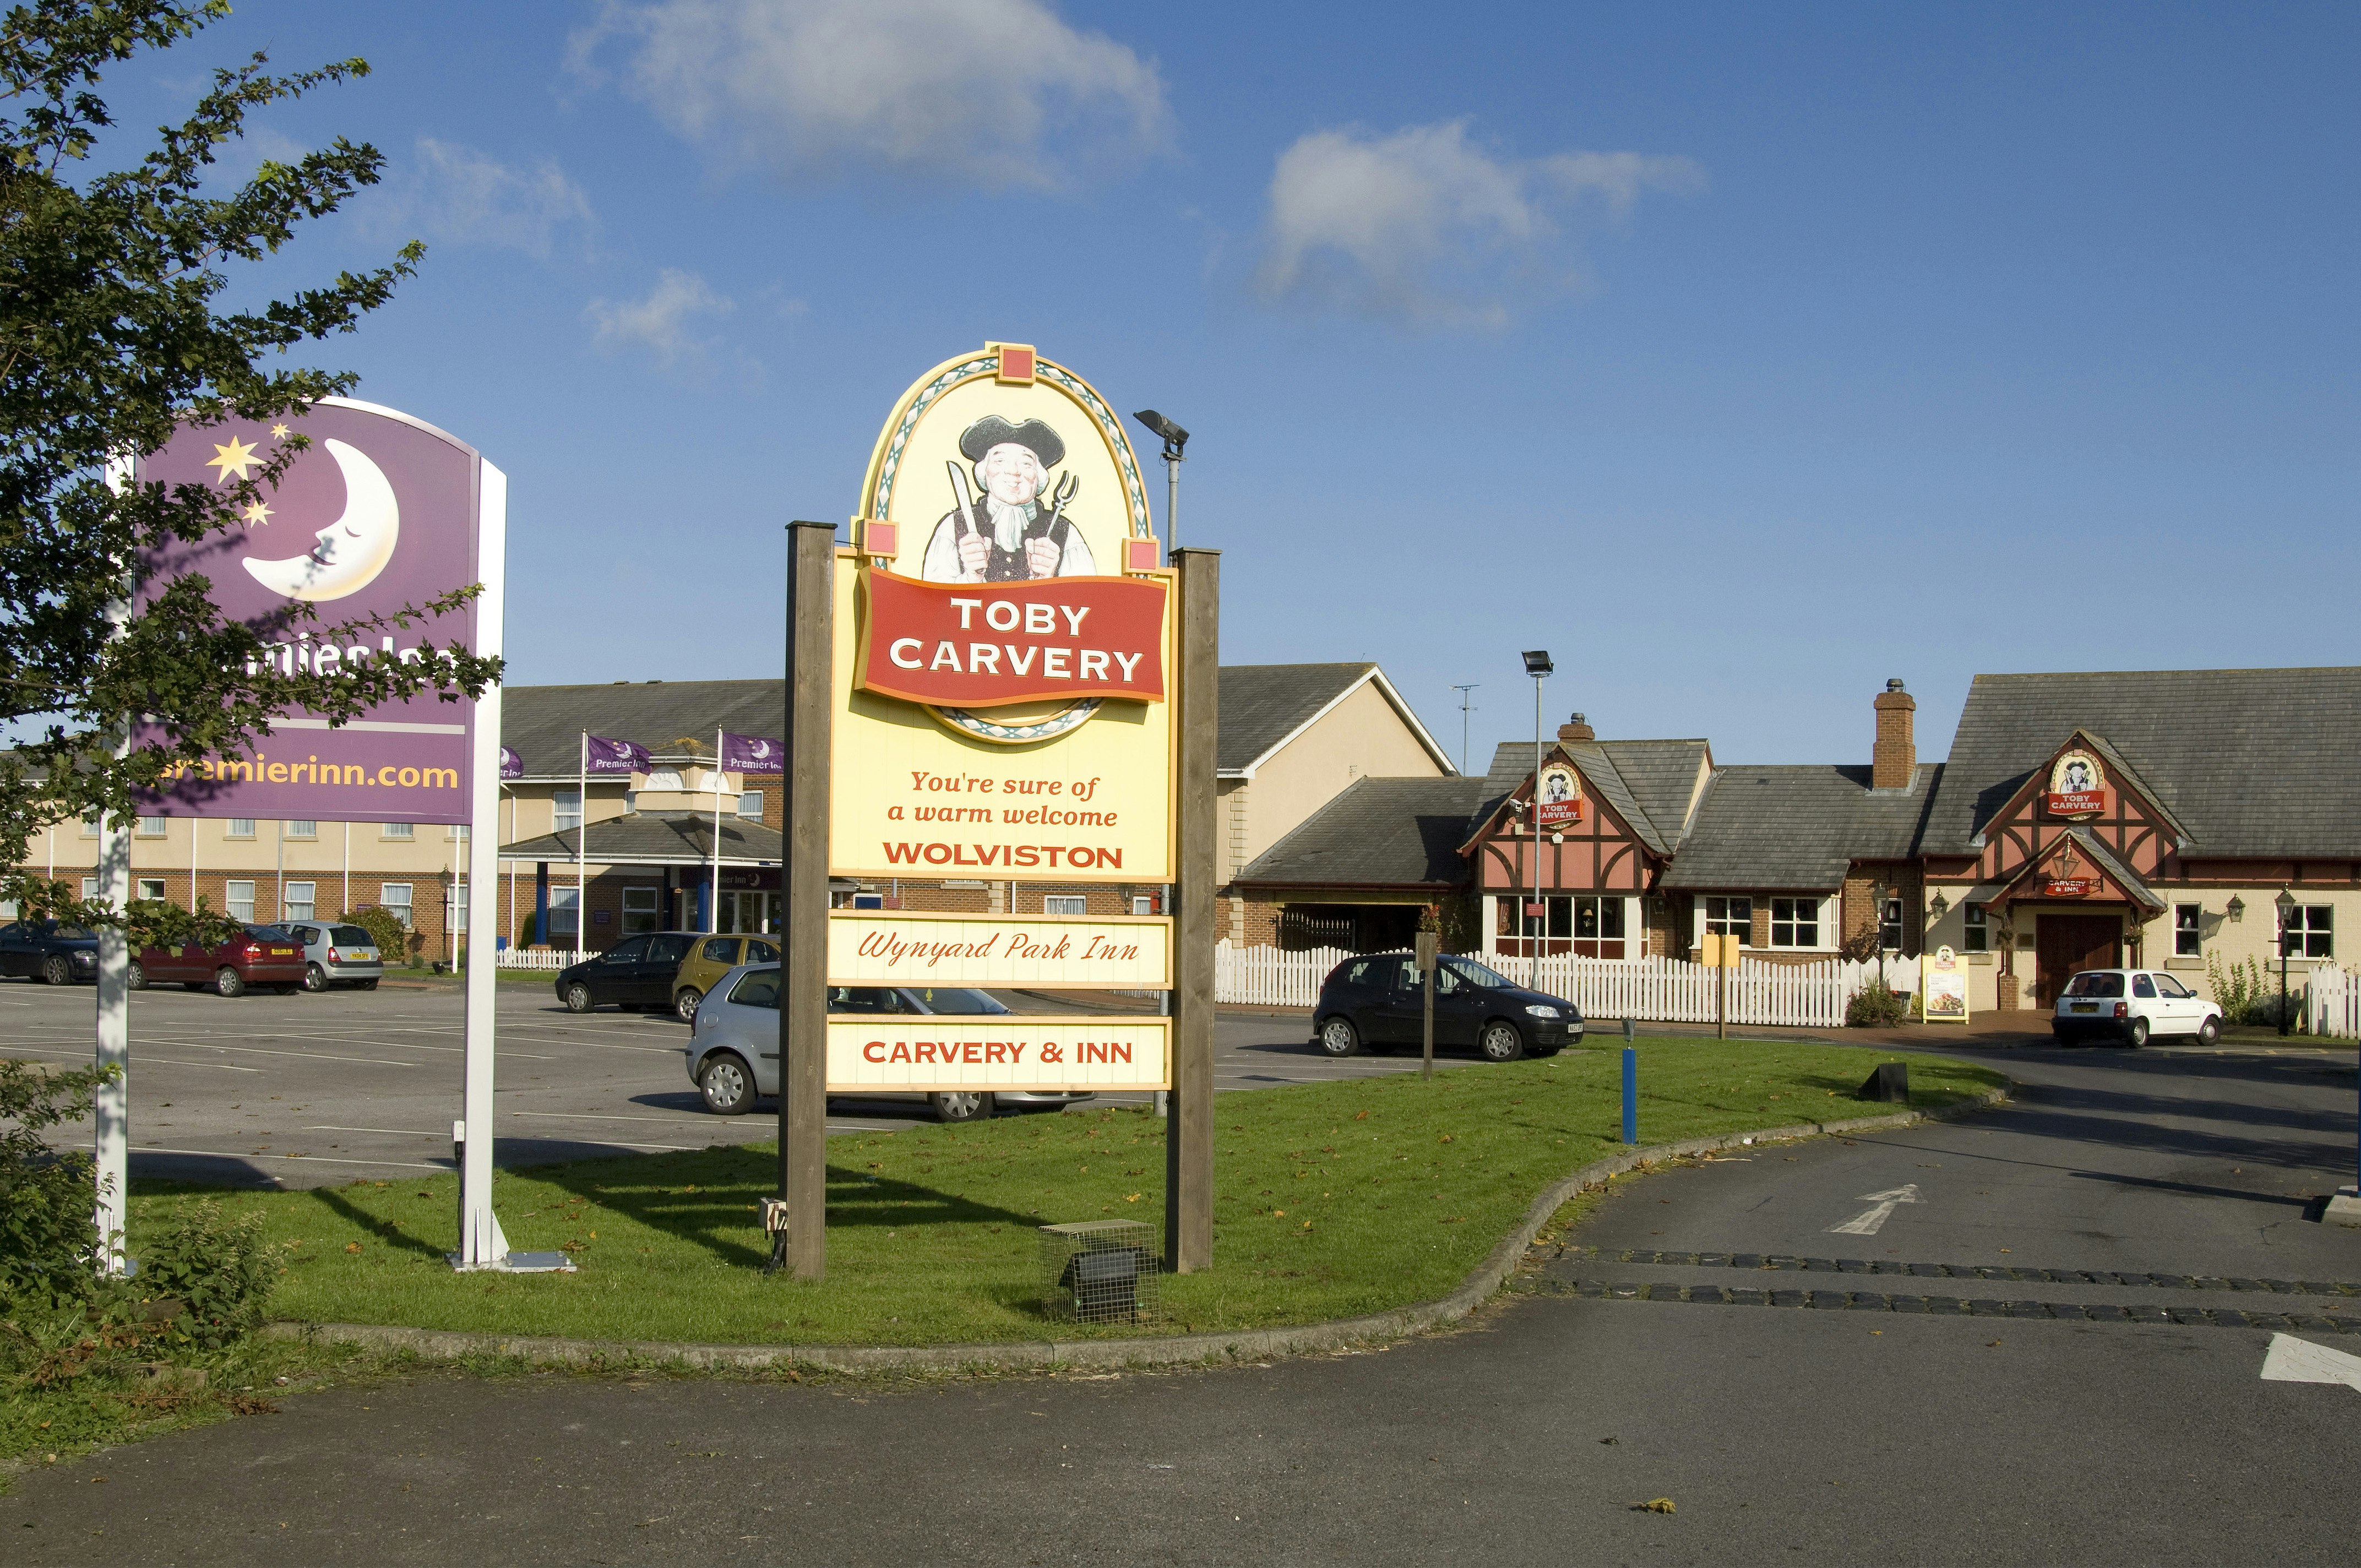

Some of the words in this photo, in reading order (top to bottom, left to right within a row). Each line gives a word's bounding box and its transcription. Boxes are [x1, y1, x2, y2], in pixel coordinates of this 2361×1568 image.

[951, 597, 1091, 637] TOBY
[889, 637, 1145, 683] CARVERY
[596, 759, 632, 769] Premier
[731, 758, 769, 769] Premier
[911, 771, 994, 793] You're
[1003, 778, 1062, 796] sure
[1071, 777, 1101, 802] of
[888, 805, 905, 821] a
[915, 806, 993, 823] warm
[1003, 805, 1118, 827] welcome
[882, 842, 1122, 869] WOLVISTON
[858, 931, 999, 967] Wynyard
[1004, 933, 1071, 960] Park
[1080, 935, 1139, 960] Inn
[863, 1041, 1027, 1064] CARVERY
[1040, 1042, 1063, 1064] &
[1077, 1042, 1132, 1064] INN
